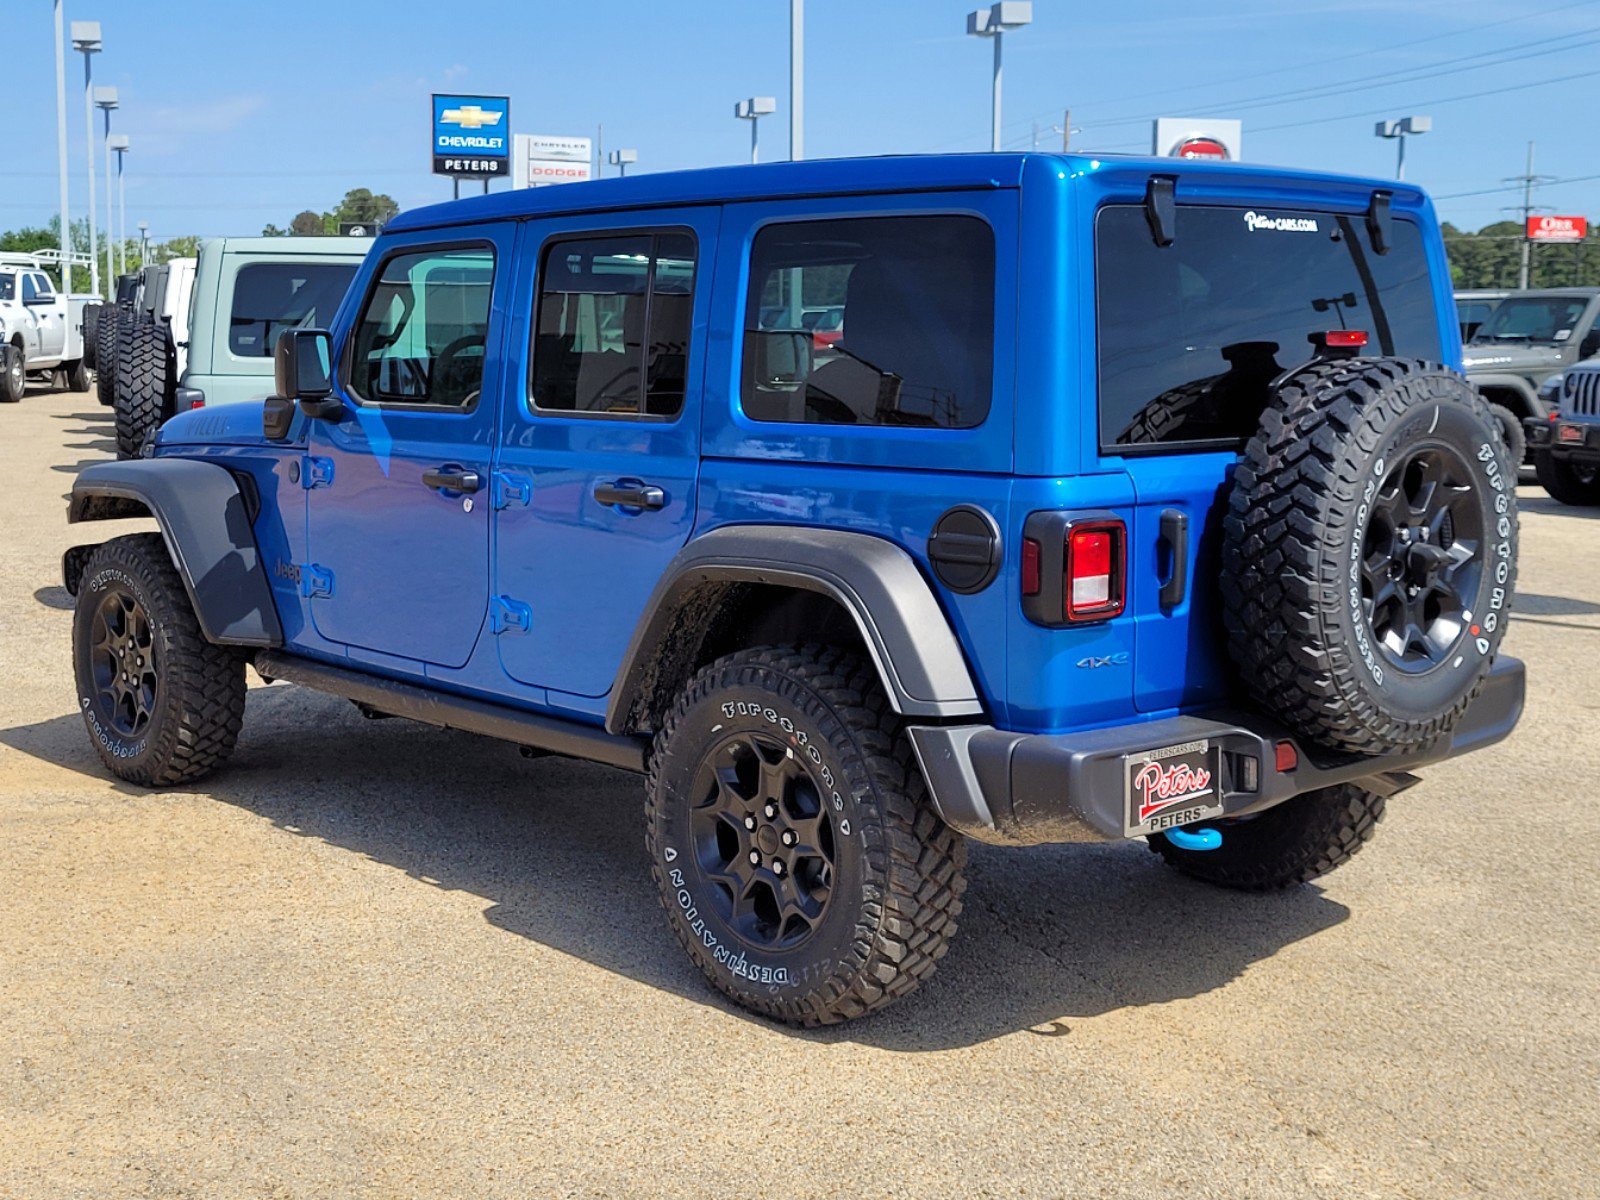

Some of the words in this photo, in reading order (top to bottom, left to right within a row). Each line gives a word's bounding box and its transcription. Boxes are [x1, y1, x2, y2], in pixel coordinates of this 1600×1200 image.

[439, 136, 503, 148] CHEVROLET
[445, 160, 498, 171] PETERS
[533, 168, 588, 176] DODGE
[275, 557, 301, 584] Jeep
[1135, 762, 1211, 807] Peters
[1150, 808, 1201, 831] PETERS
[668, 868, 788, 984] DESTINATION
